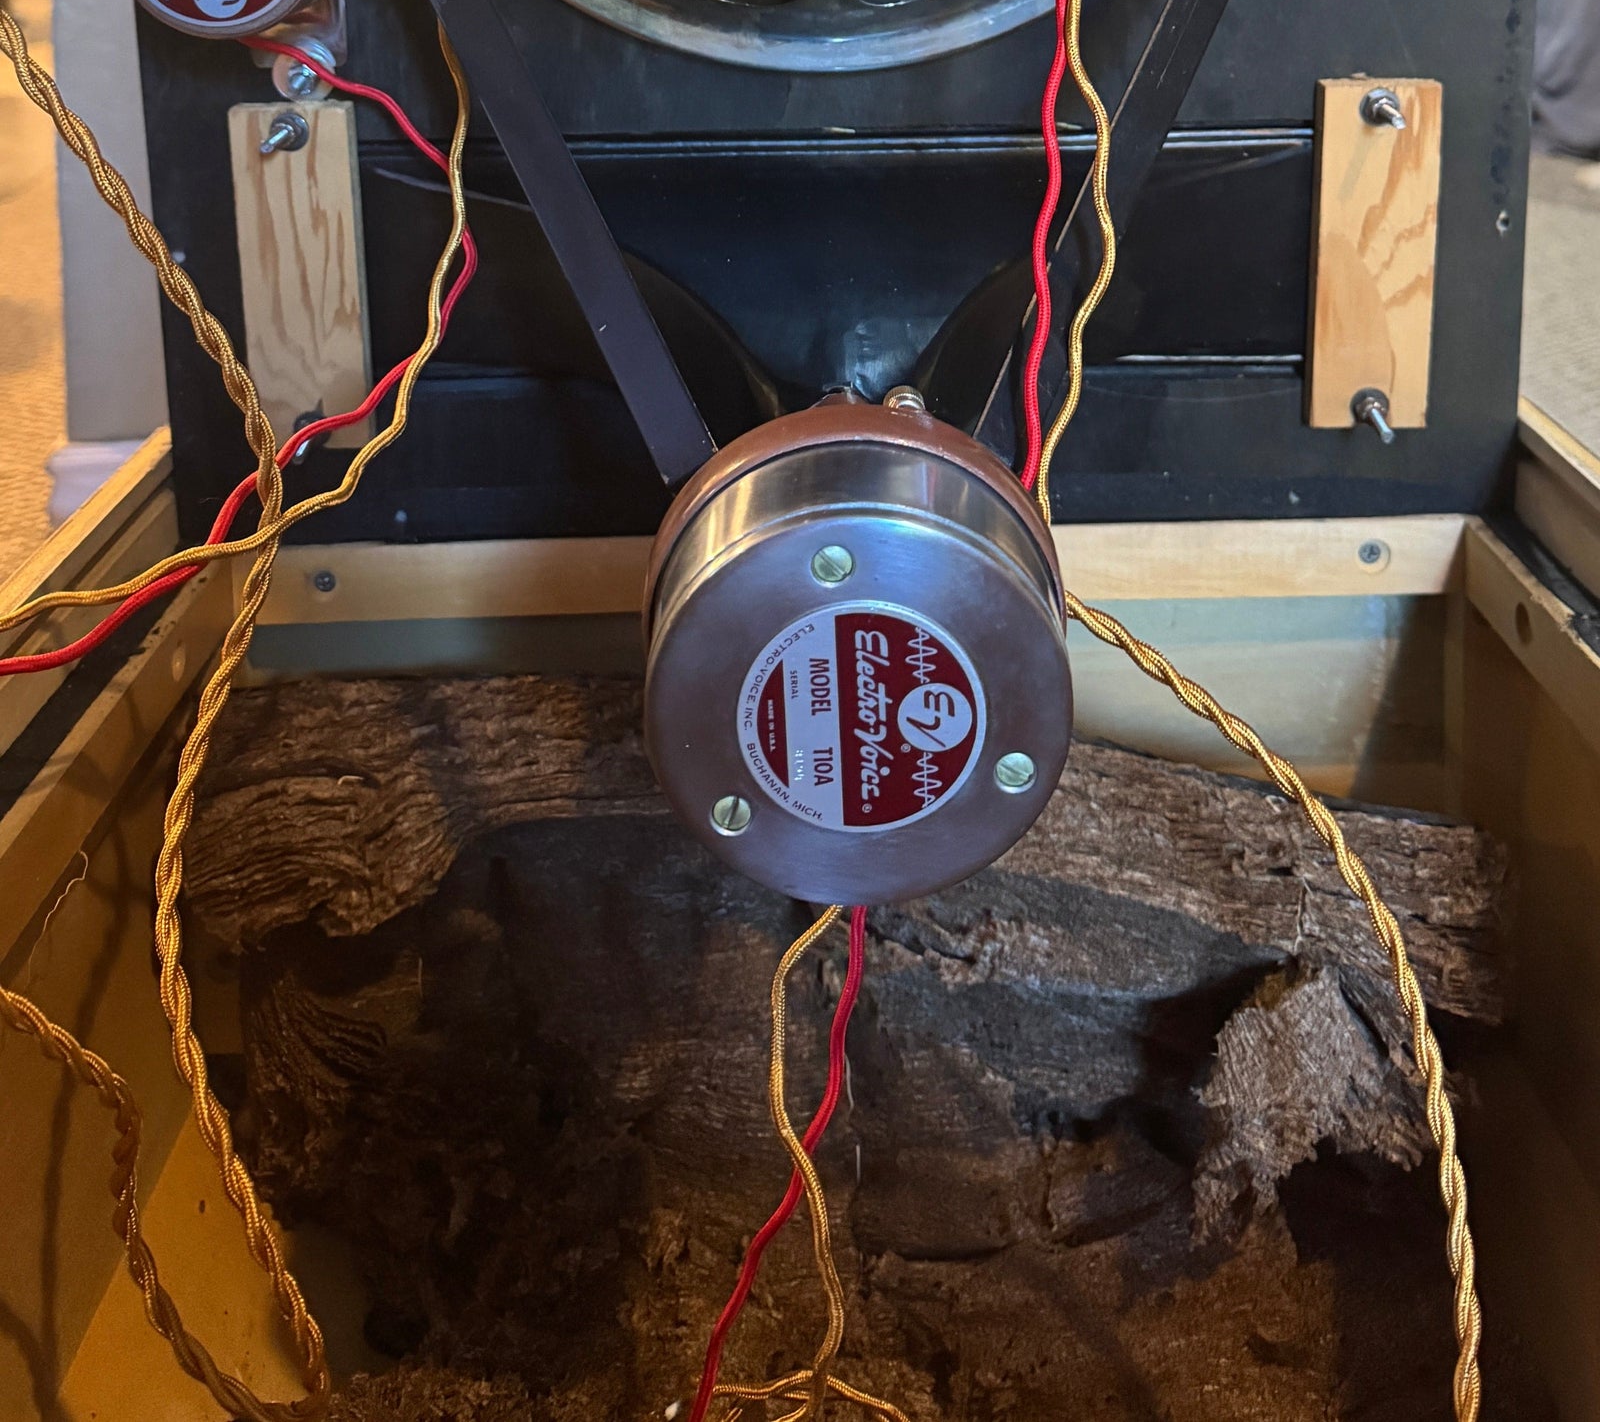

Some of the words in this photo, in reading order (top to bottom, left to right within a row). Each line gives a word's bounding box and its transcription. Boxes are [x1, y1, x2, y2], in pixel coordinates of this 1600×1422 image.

[790, 670, 798, 700] SERIAL
[808, 657, 832, 716] MODEL
[743, 707, 753, 732] INC.
[747, 742, 790, 804] BUCHANAN,
[792, 800, 823, 821] MICH.
